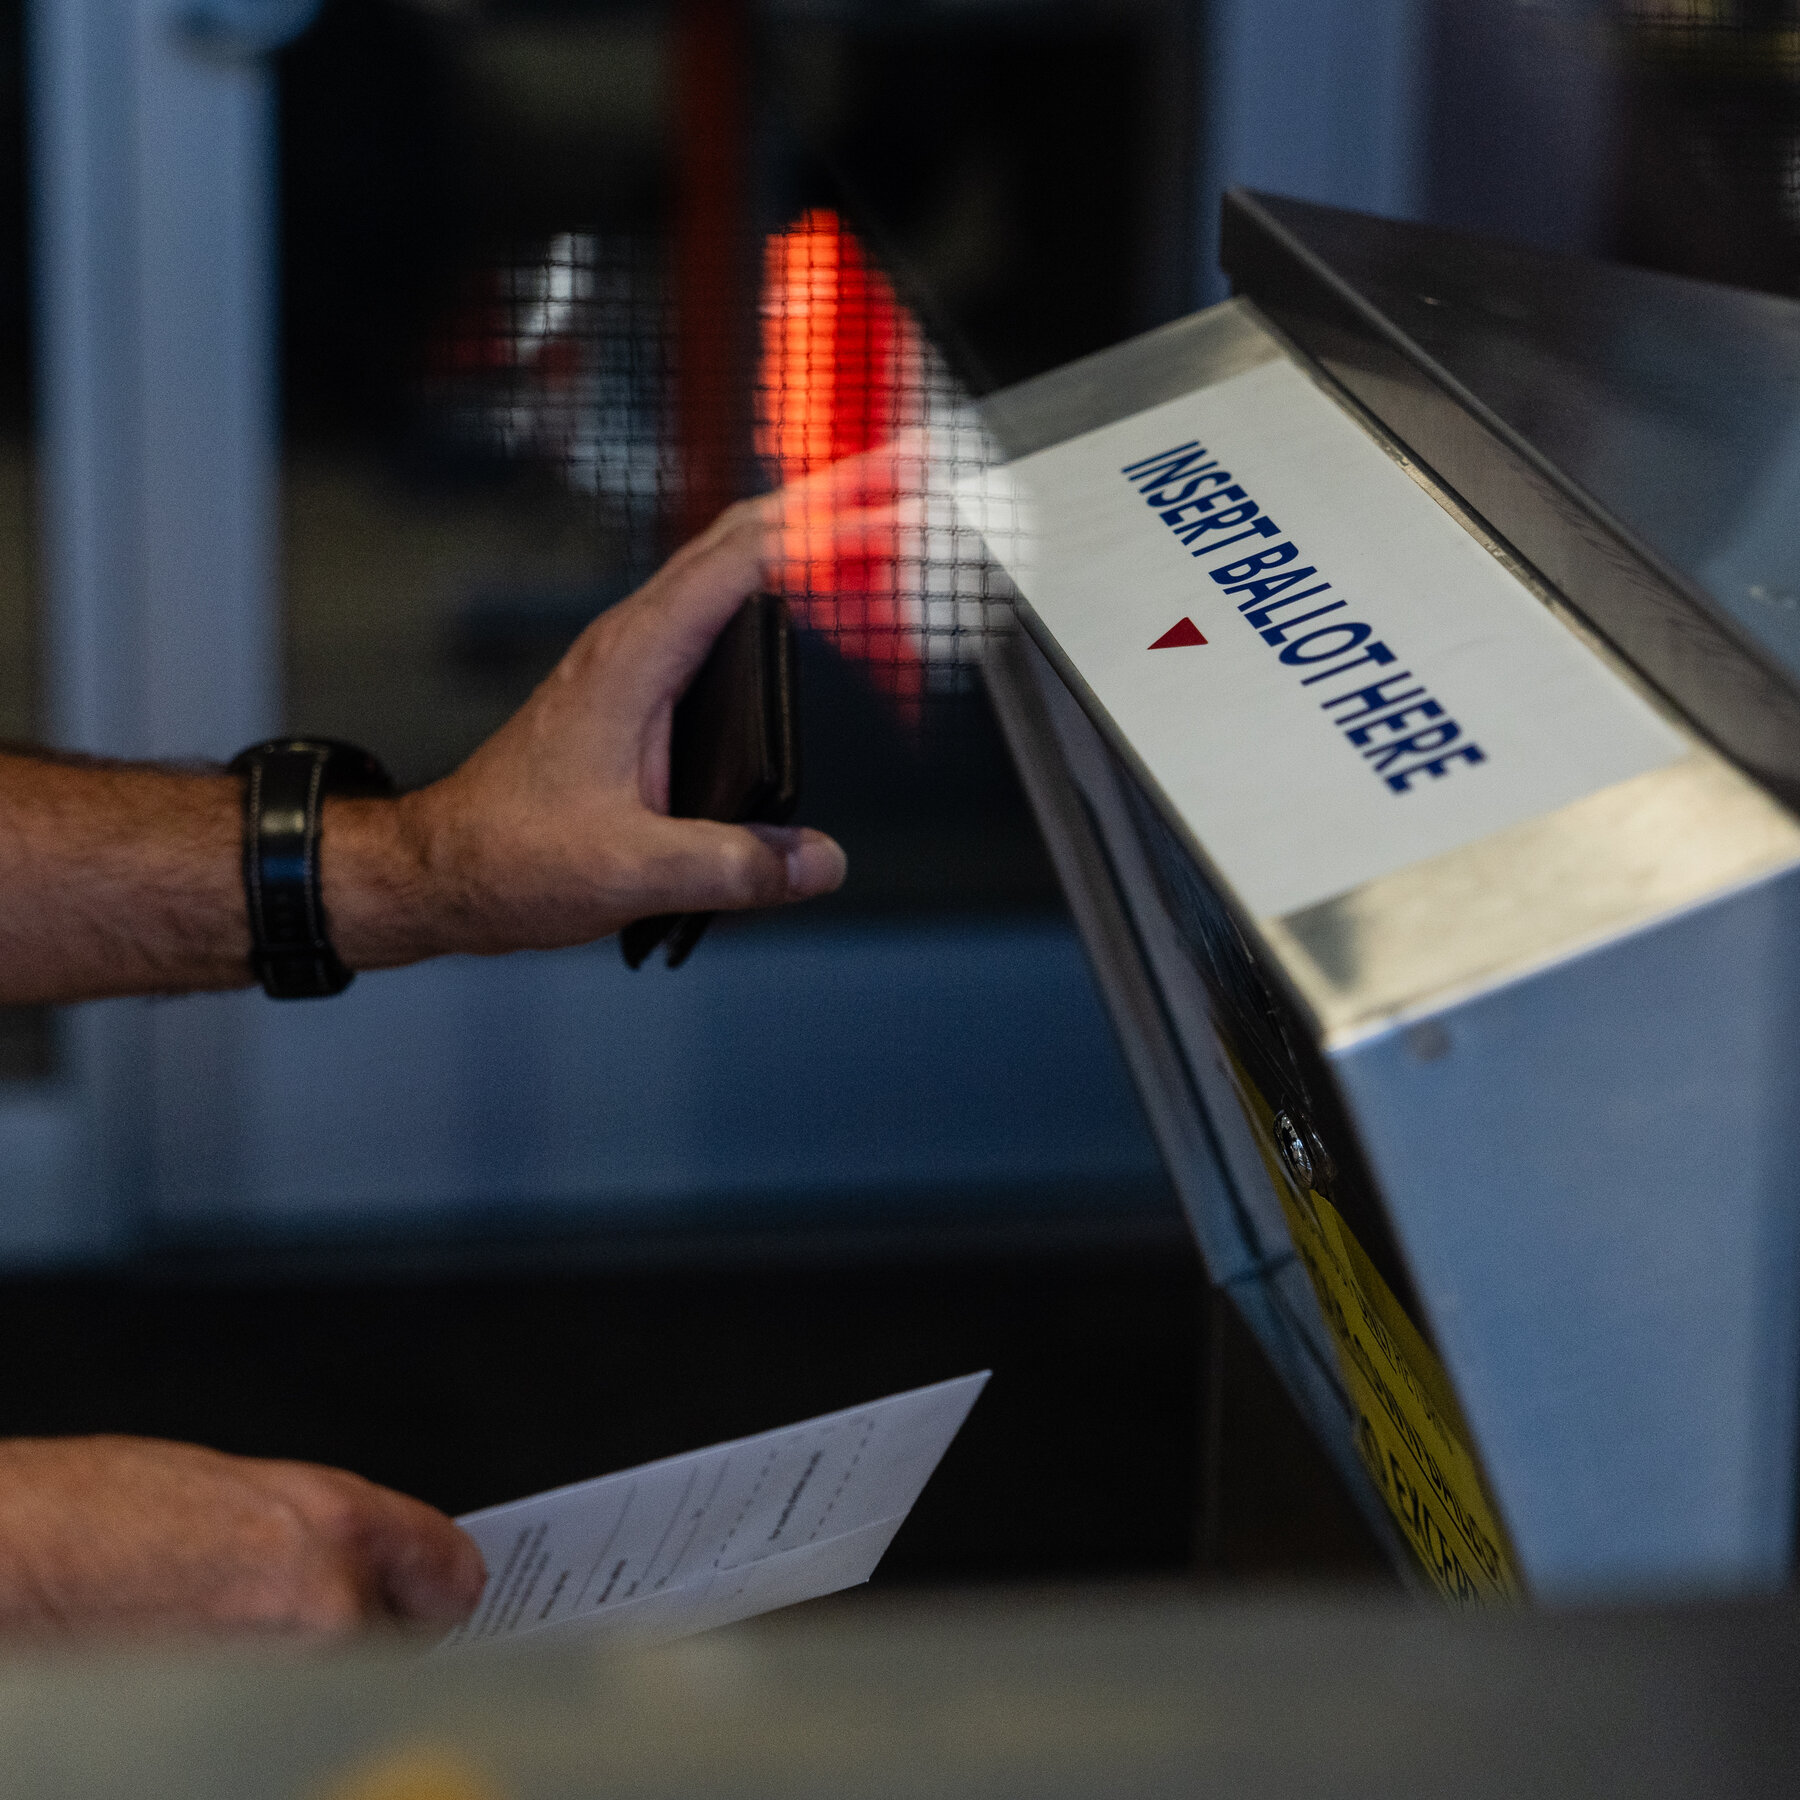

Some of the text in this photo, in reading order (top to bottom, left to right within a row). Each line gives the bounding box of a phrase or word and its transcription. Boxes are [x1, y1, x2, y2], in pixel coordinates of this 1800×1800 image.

[1121, 440, 1487, 795] INSERT BALLOT HERE
